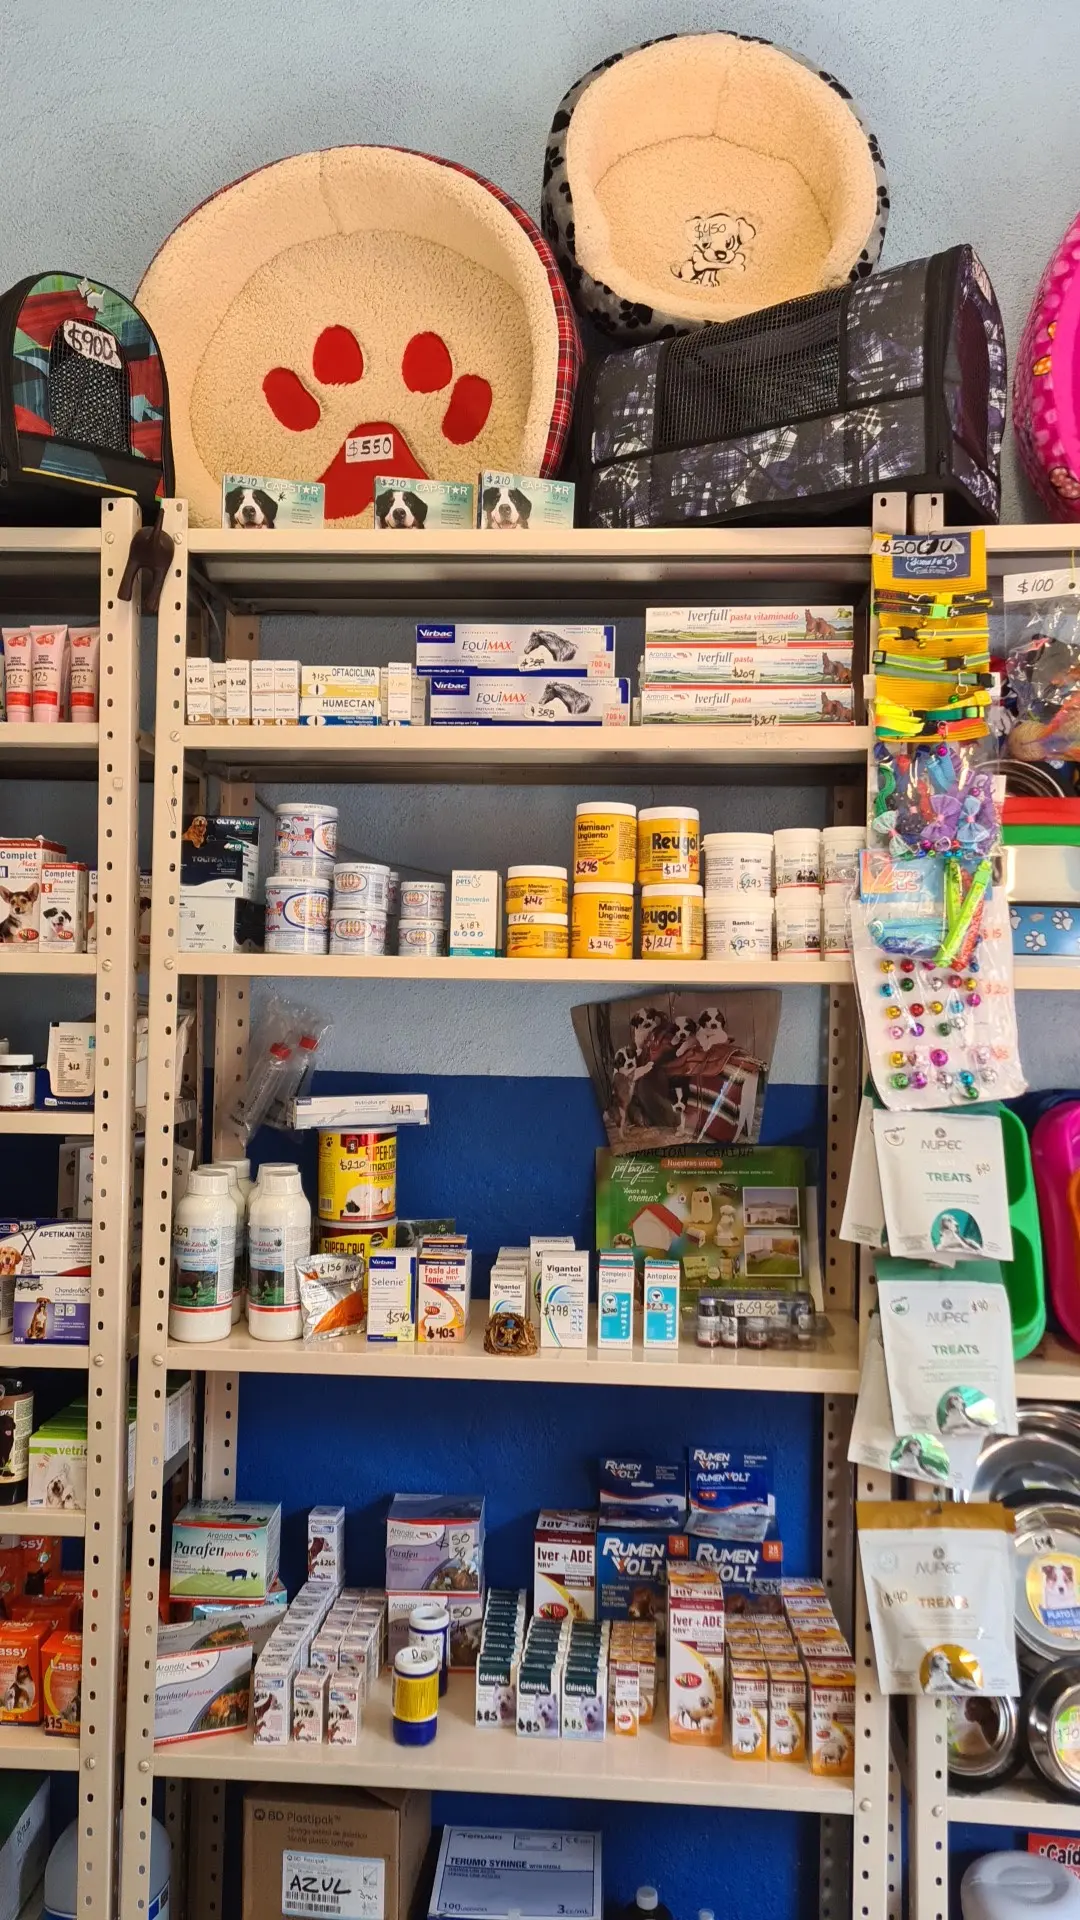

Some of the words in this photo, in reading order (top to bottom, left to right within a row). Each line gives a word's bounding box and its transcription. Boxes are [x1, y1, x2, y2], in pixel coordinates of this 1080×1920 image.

[66, 325, 117, 361] $900
[346, 436, 392, 457] $550
[229, 476, 258, 487] $210
[380, 478, 407, 489] $210
[486, 475, 511, 486] $210
[1017, 578, 1054, 593] $100
[687, 609, 730, 624] Iverfull
[730, 614, 751, 623] pasta
[419, 629, 453, 638] Virbac
[697, 652, 732, 665] Iverfull
[733, 656, 754, 665] pasta
[332, 668, 376, 678] OFTACICLINA
[433, 681, 468, 690] Virbac
[322, 700, 375, 708] HUMECTAN
[694, 693, 730, 705] Iverfull
[0, 851, 37, 861] Complet
[664, 863, 687, 874] $124
[588, 939, 614, 949] $246
[921, 1140, 963, 1150] NUPEC
[339, 1159, 366, 1171] $210
[926, 1172, 972, 1183] TREATS
[547, 1265, 582, 1273] Vigantol
[371, 1277, 404, 1286] Selenie
[425, 1275, 443, 1284] Tonic
[493, 1283, 521, 1291] Vigantol
[736, 1301, 762, 1314] $69
[387, 1309, 410, 1325] $540
[927, 1312, 969, 1323] NUPEC
[426, 1326, 455, 1339] $405
[932, 1344, 980, 1355] TREATS
[694, 1450, 730, 1461] RUMEN
[605, 1460, 642, 1471] RUMEN
[612, 1470, 640, 1479] VOLT
[173, 1541, 225, 1559] Parafen
[602, 1538, 665, 1557] RUMEN
[537, 1547, 560, 1561] Iver
[570, 1549, 593, 1563] ADE
[695, 1544, 759, 1564] RUMEN
[611, 1556, 663, 1576] VOLT
[918, 1596, 969, 1609] TREAS
[673, 1614, 692, 1627] Iver
[702, 1614, 722, 1628] ADE
[0, 1647, 28, 1658] assy
[51, 1659, 80, 1672] Lass
[268, 1811, 284, 1821] BD
[287, 1811, 334, 1825] Plastipak
[450, 1857, 487, 1867] TERUMO
[489, 1859, 528, 1869] SYRINGE
[290, 1875, 351, 1894] AZUL
[443, 1902, 461, 1911] 100
